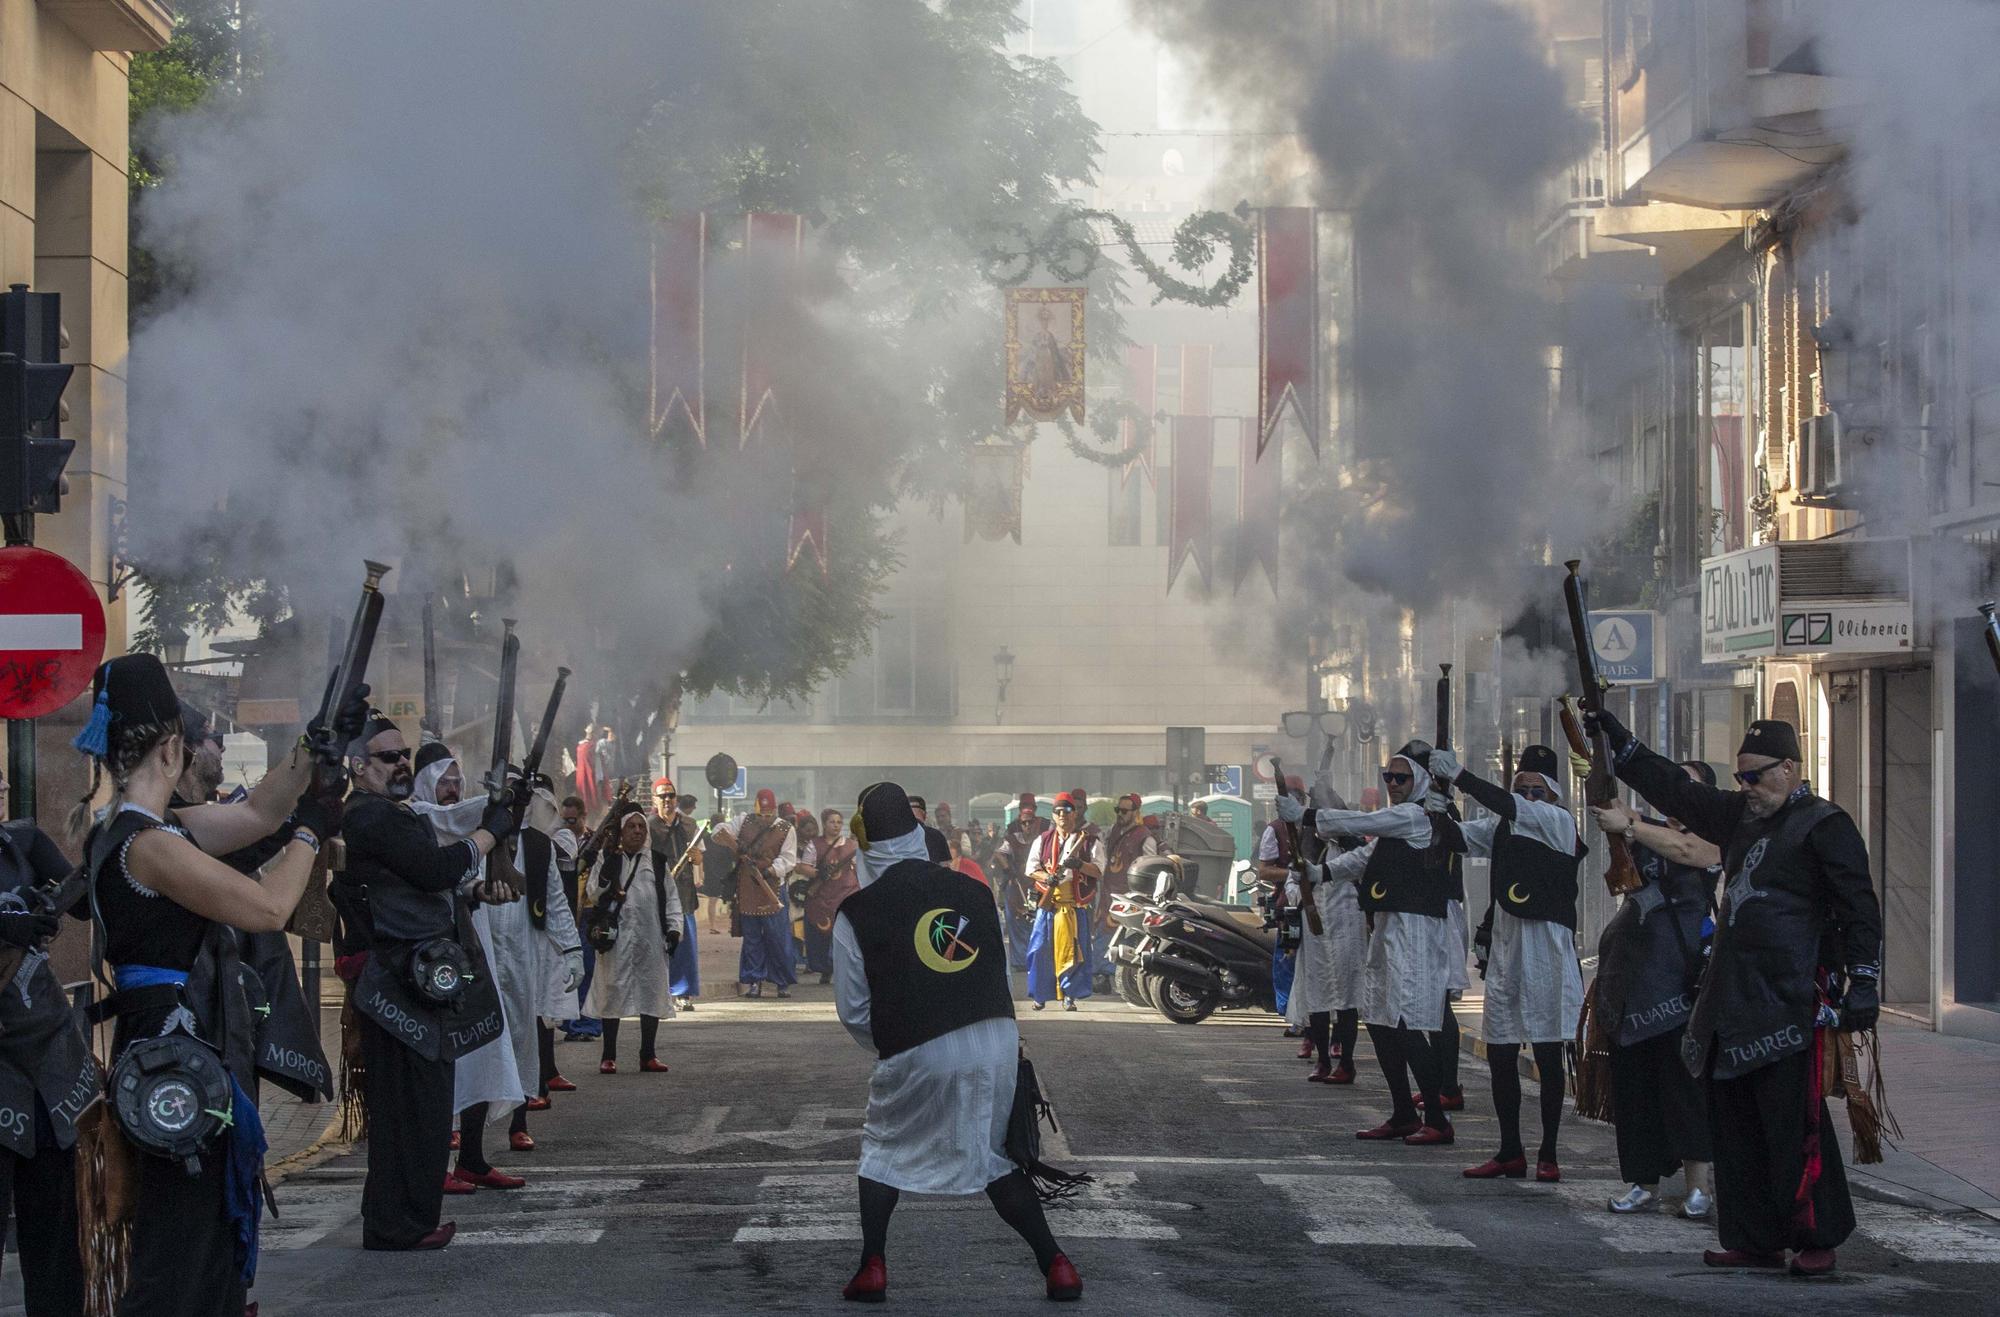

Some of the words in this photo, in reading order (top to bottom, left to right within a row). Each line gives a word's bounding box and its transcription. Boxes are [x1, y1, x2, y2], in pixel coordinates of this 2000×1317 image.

[1602, 623, 1629, 650] A
[369, 991, 429, 1042] MOROS
[448, 1011, 500, 1048] TUAREG
[265, 1042, 325, 1084] MOROS
[1724, 1024, 1804, 1067] TUAREG
